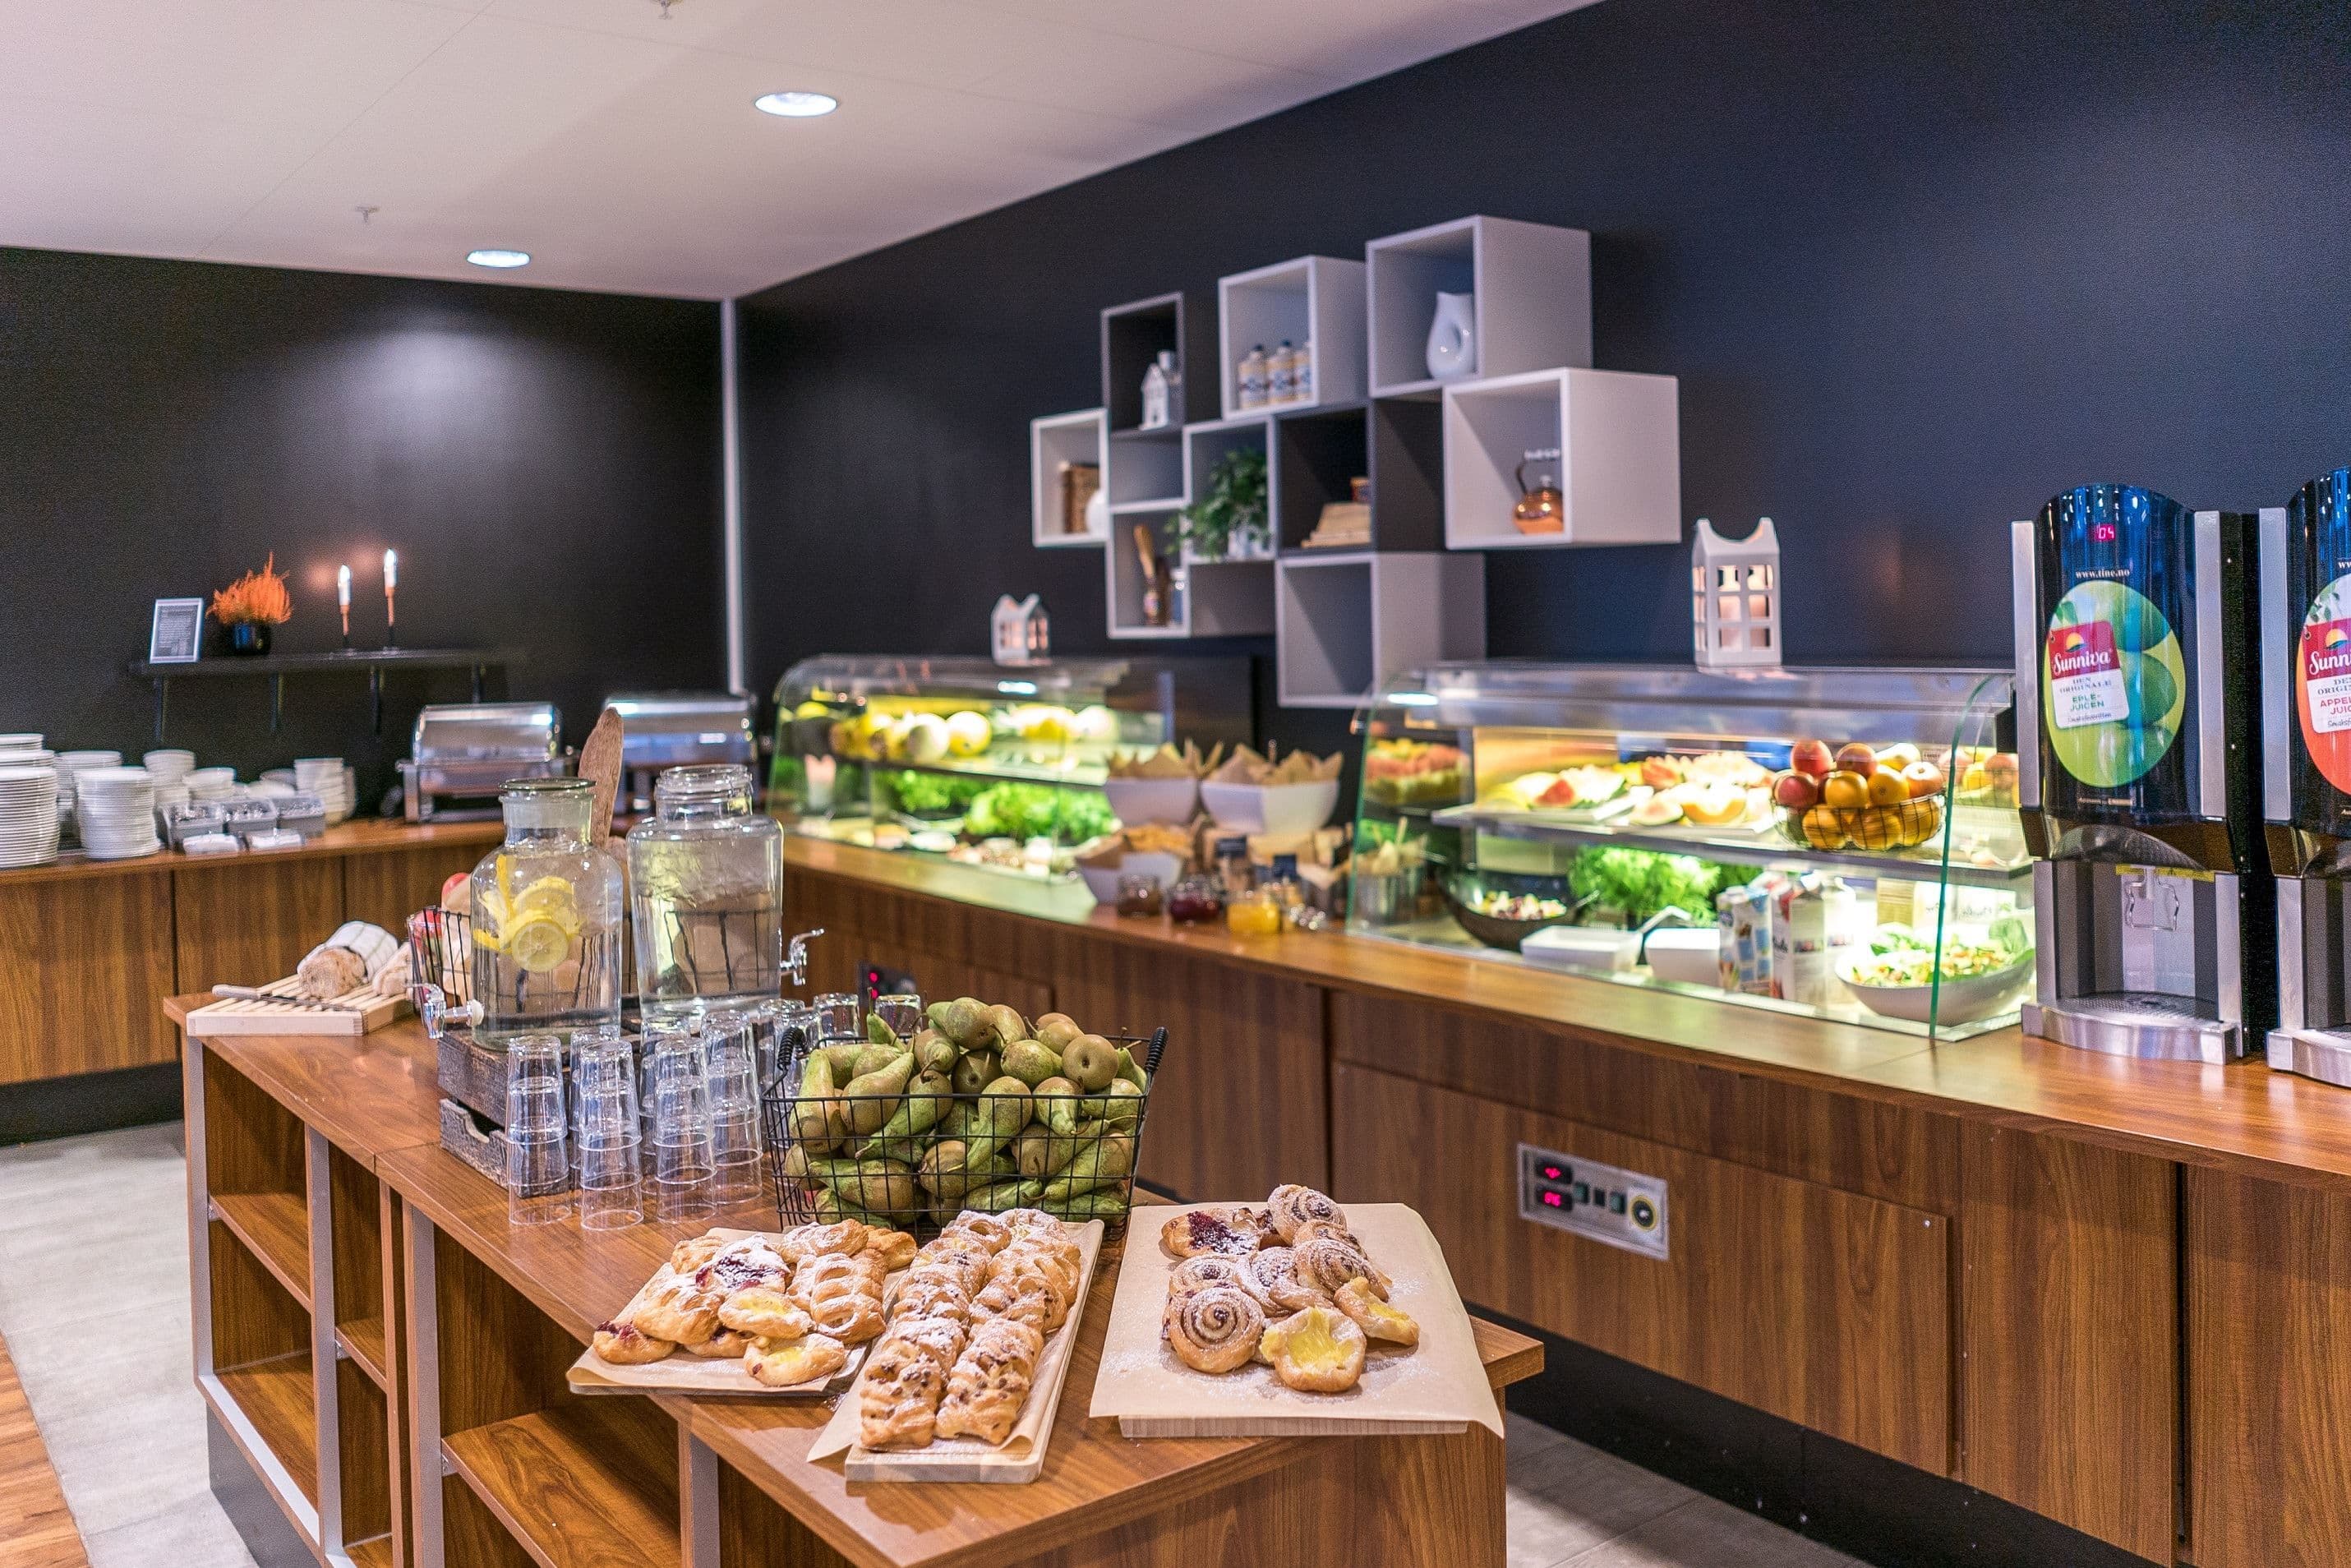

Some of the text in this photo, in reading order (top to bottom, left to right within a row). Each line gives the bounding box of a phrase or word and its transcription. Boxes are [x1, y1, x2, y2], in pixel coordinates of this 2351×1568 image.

[2076, 568, 2130, 579] www.tine.no
[2054, 650, 2111, 676] Sunniva
[2309, 651, 2351, 675] Sunn
[2317, 685, 2351, 695] ORIGI
